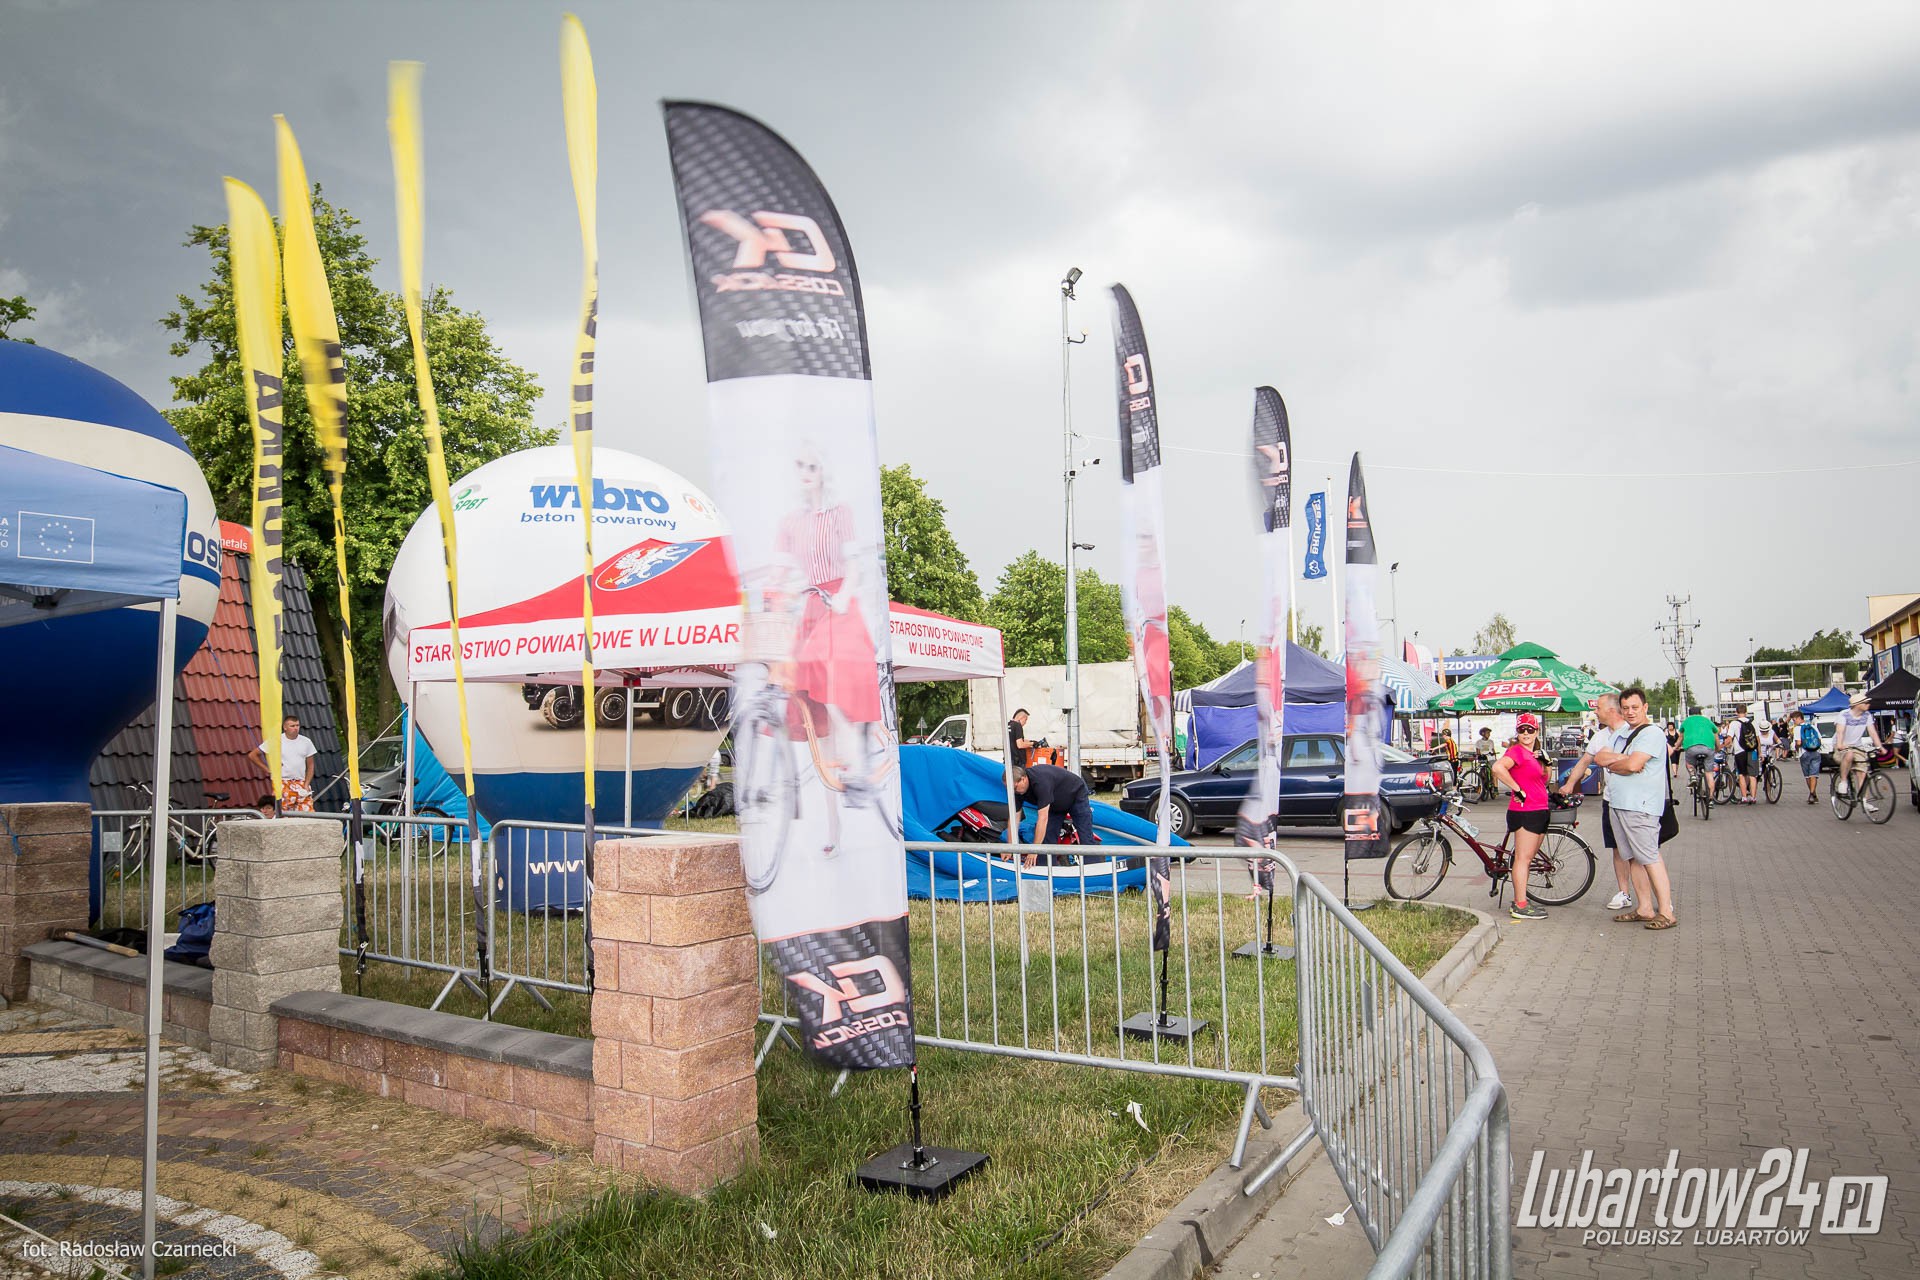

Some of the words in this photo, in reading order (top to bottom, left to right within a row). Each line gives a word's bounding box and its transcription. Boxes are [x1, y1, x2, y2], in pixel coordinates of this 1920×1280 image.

[521, 512, 575, 523] beton
[591, 514, 676, 531] owarowy
[889, 620, 941, 640] STAROSTWO
[942, 628, 984, 649] POWIATOWE
[415, 638, 511, 663] STAROSTWO
[516, 629, 633, 656] POWIATOWE
[639, 627, 659, 647] W
[909, 641, 918, 655] W
[919, 643, 971, 662] LUBARTOWIE
[1483, 682, 1554, 695] PERŁA
[529, 860, 584, 875] ww
